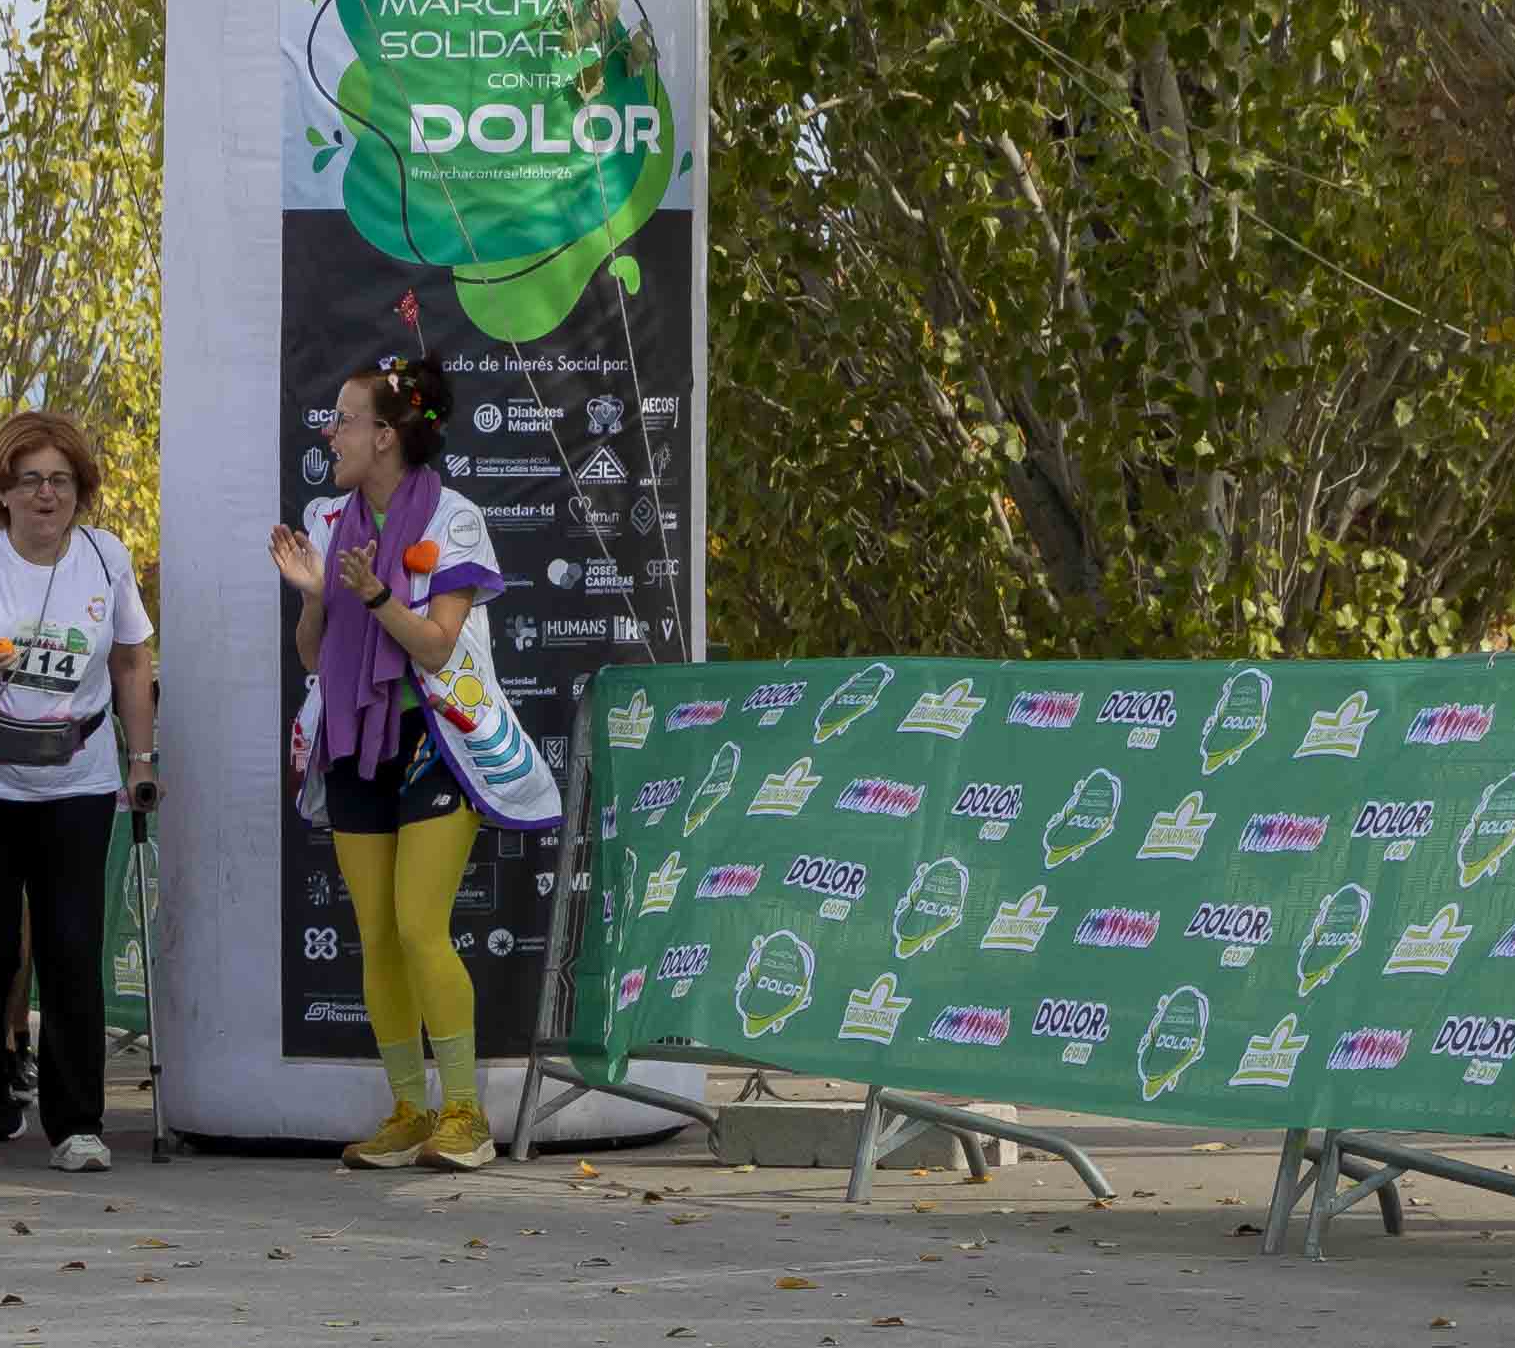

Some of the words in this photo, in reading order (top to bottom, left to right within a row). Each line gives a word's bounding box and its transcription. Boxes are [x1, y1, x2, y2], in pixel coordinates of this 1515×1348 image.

[409, 102, 662, 155] DOLOR
[479, 355, 500, 372] de
[504, 355, 553, 372] Interés
[558, 354, 601, 372] Social
[507, 405, 565, 419] Diabetes
[507, 419, 553, 432] Madrid
[547, 620, 607, 635] HUMANS
